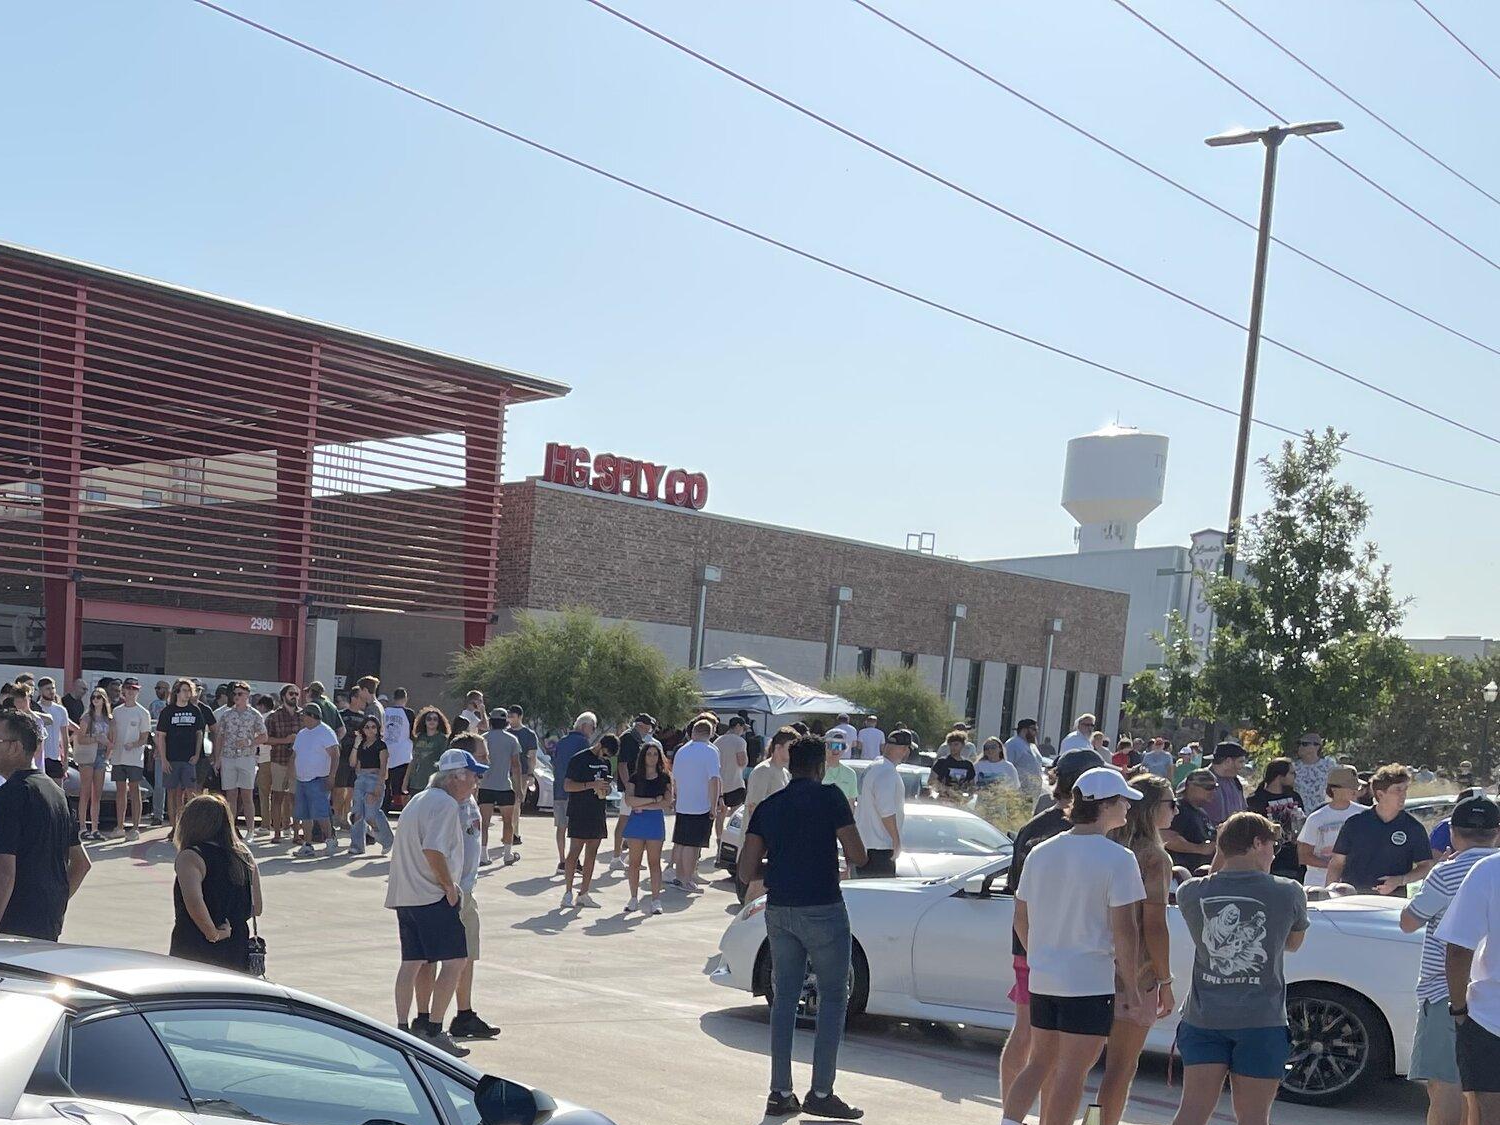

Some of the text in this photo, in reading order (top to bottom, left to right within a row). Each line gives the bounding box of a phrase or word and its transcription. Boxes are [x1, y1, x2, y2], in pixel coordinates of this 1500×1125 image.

[544, 442, 708, 511] HG SPLY CO
[250, 617, 274, 631] 2980
